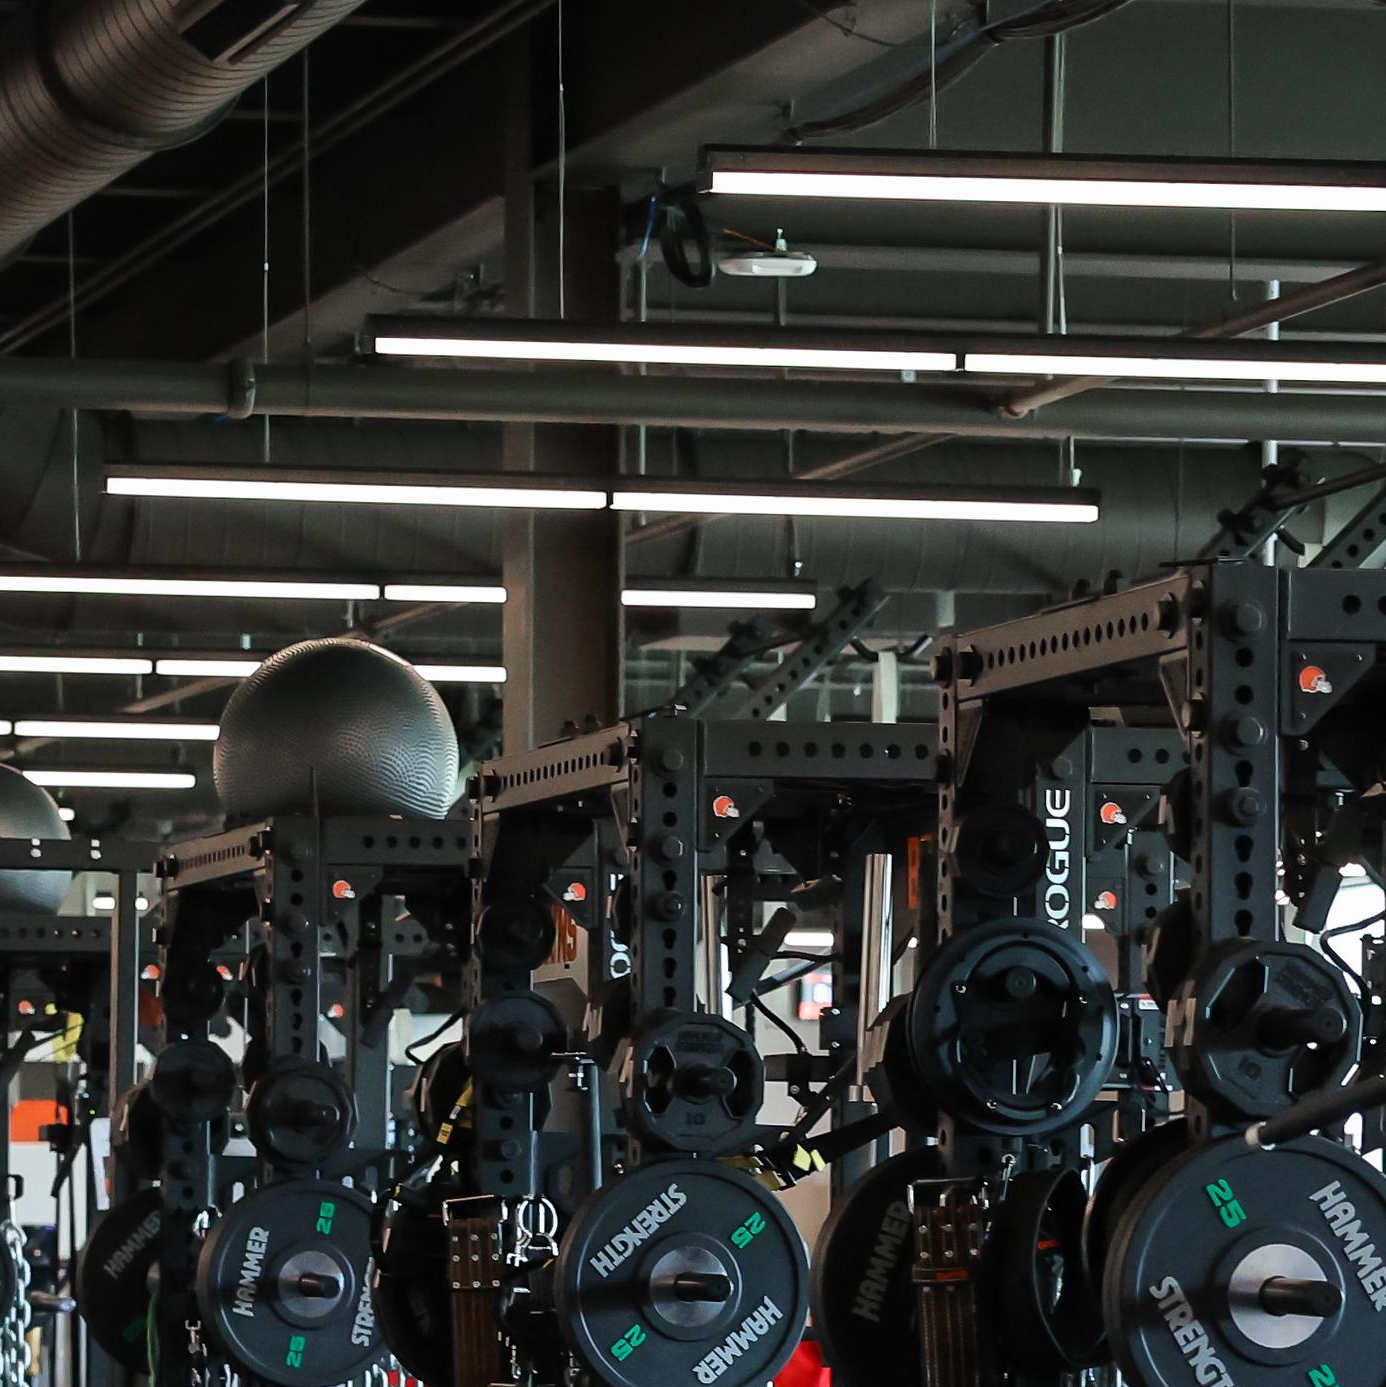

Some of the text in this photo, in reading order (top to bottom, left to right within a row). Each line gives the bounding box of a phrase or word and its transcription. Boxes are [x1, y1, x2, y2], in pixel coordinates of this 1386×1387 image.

[316, 1201, 336, 1235] 25
[1205, 1178, 1247, 1230] 25
[589, 1183, 688, 1279] STRENGTH
[729, 1210, 766, 1250] 25
[232, 1226, 270, 1318] HAMMER
[286, 1335, 306, 1369] 25
[610, 1323, 647, 1362] 25
[692, 1295, 784, 1385] HAMMER
